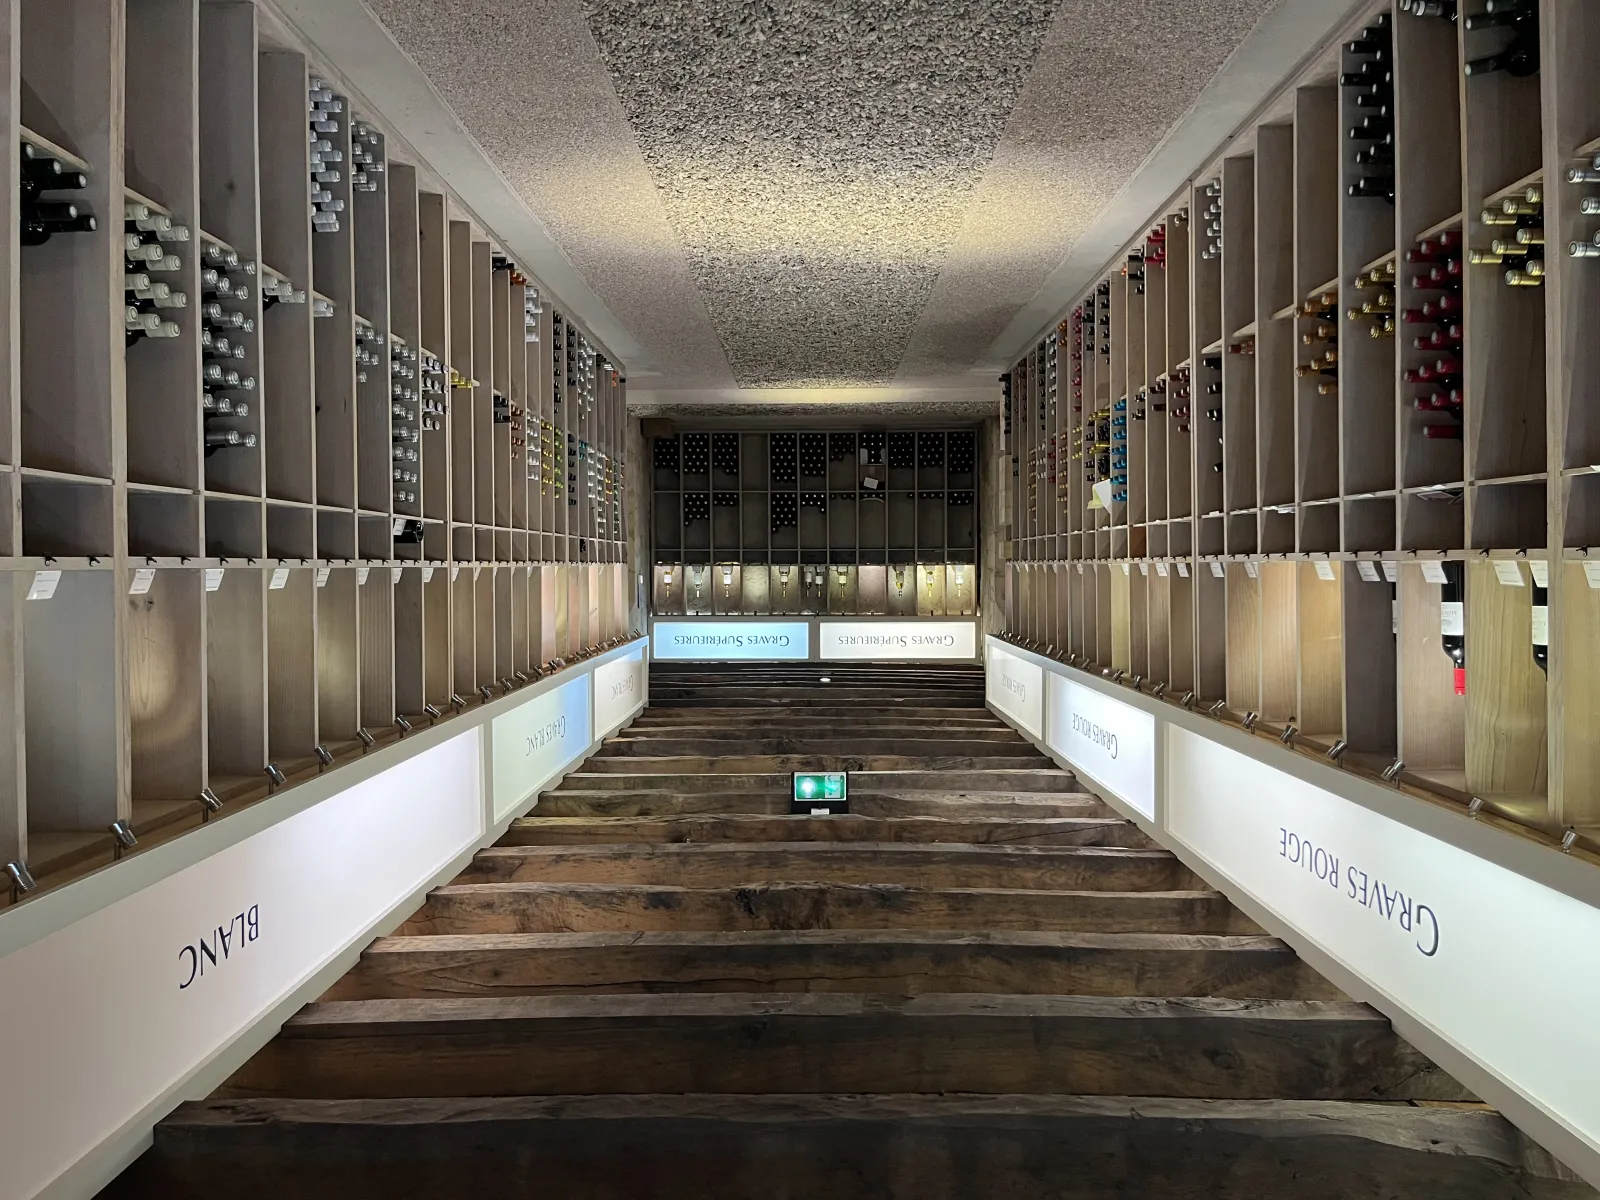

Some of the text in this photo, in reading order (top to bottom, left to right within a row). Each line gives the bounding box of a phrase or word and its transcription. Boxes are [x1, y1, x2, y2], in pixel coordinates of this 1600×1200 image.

[674, 635, 790, 648] GRAVES SUPÉRIEURES
[838, 635, 955, 648] GRAVES SUPÉRIEURES
[525, 715, 566, 757] GRAVES BLANC
[1072, 712, 1118, 760] GRAVES ROUGE
[1279, 827, 1440, 957] GRAVES ROUGE
[178, 903, 259, 990] BLANC
